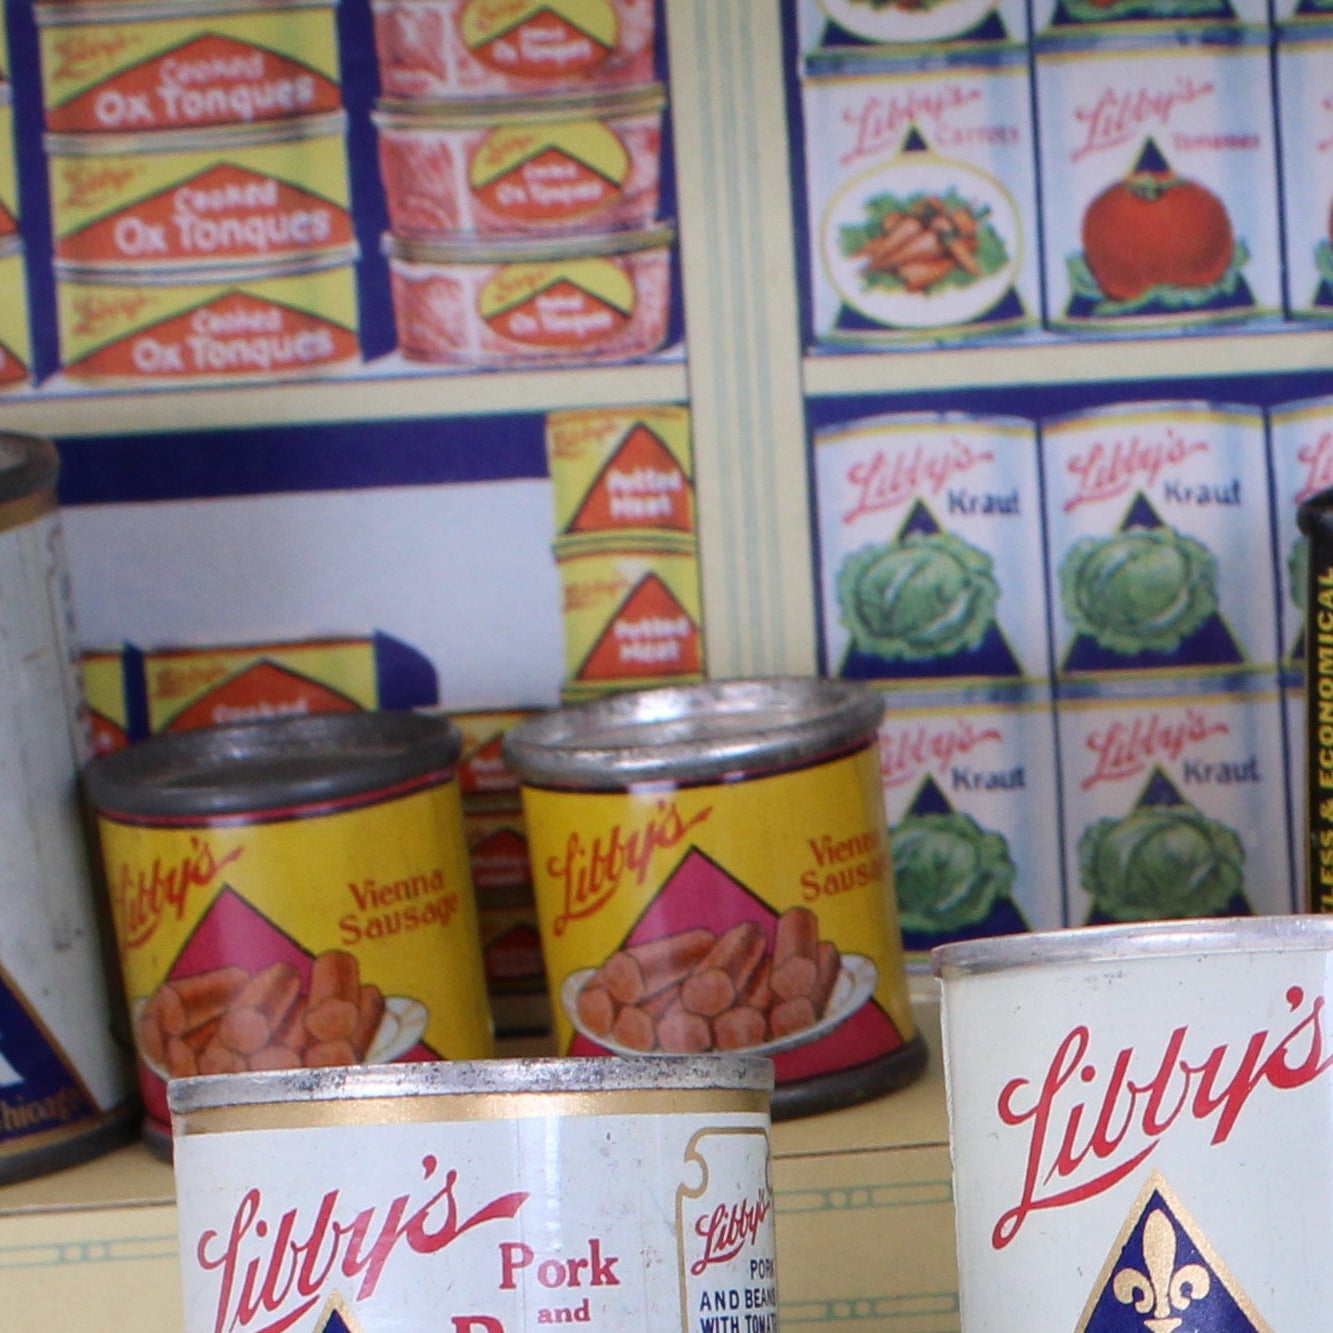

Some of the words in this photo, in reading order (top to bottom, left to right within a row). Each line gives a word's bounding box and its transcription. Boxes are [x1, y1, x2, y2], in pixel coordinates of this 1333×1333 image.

[113, 217, 169, 253] Ox
[172, 210, 331, 251] Tongues
[843, 437, 995, 524] Libby's
[1063, 427, 1209, 512] Libby's
[1163, 479, 1242, 506] Kraut
[948, 488, 1020, 515] Kraut
[349, 869, 446, 912] Vienna
[546, 798, 714, 938] Libby's
[338, 891, 460, 947] Sausage
[499, 1238, 621, 1292] Pork
[536, 1299, 592, 1325] and
